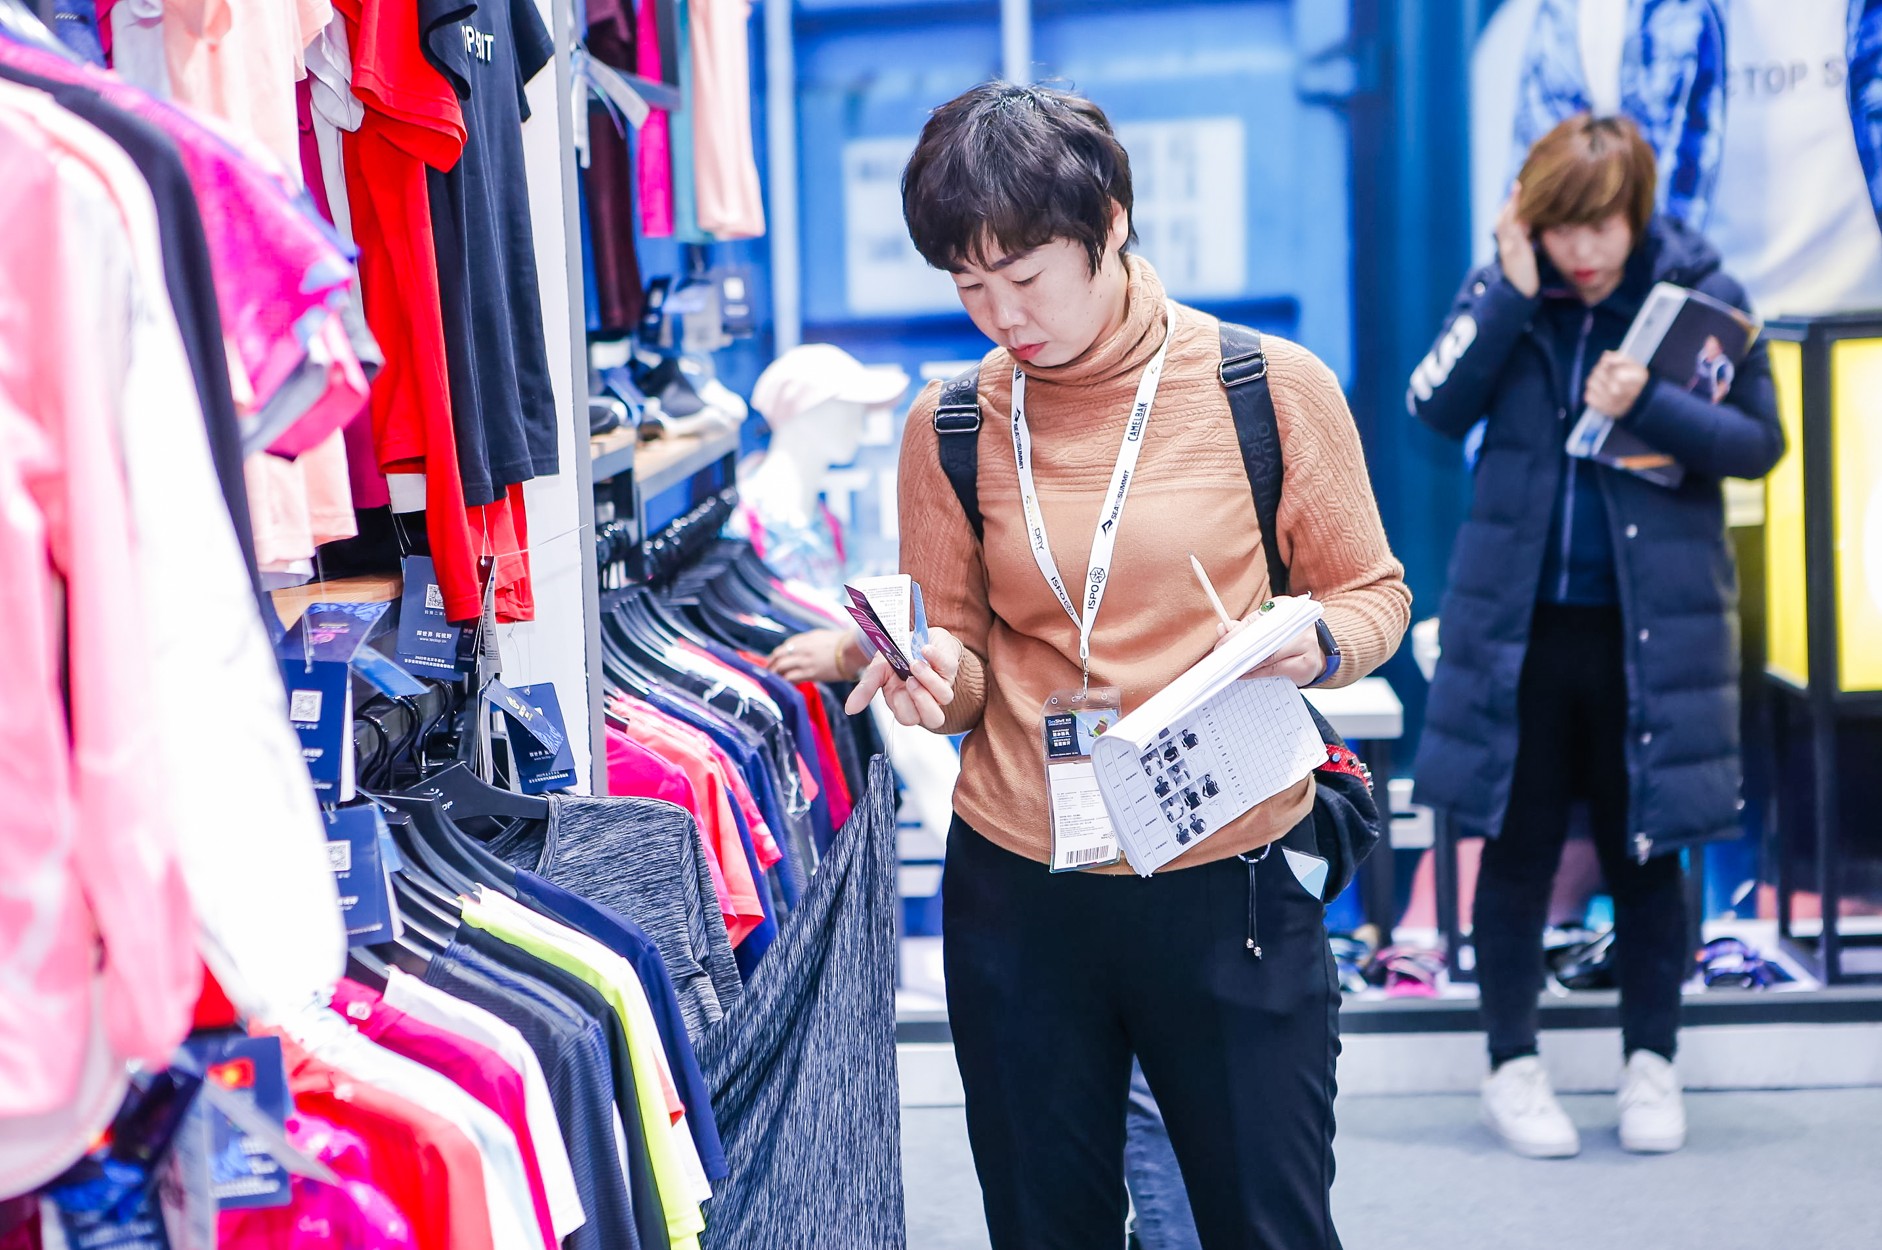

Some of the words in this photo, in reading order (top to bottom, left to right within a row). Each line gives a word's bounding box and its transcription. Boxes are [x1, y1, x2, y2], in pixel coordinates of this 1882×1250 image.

[1127, 402, 1148, 442] CAMELBAK
[1050, 576, 1066, 601] ISPO
[1087, 584, 1100, 610] ISPO
